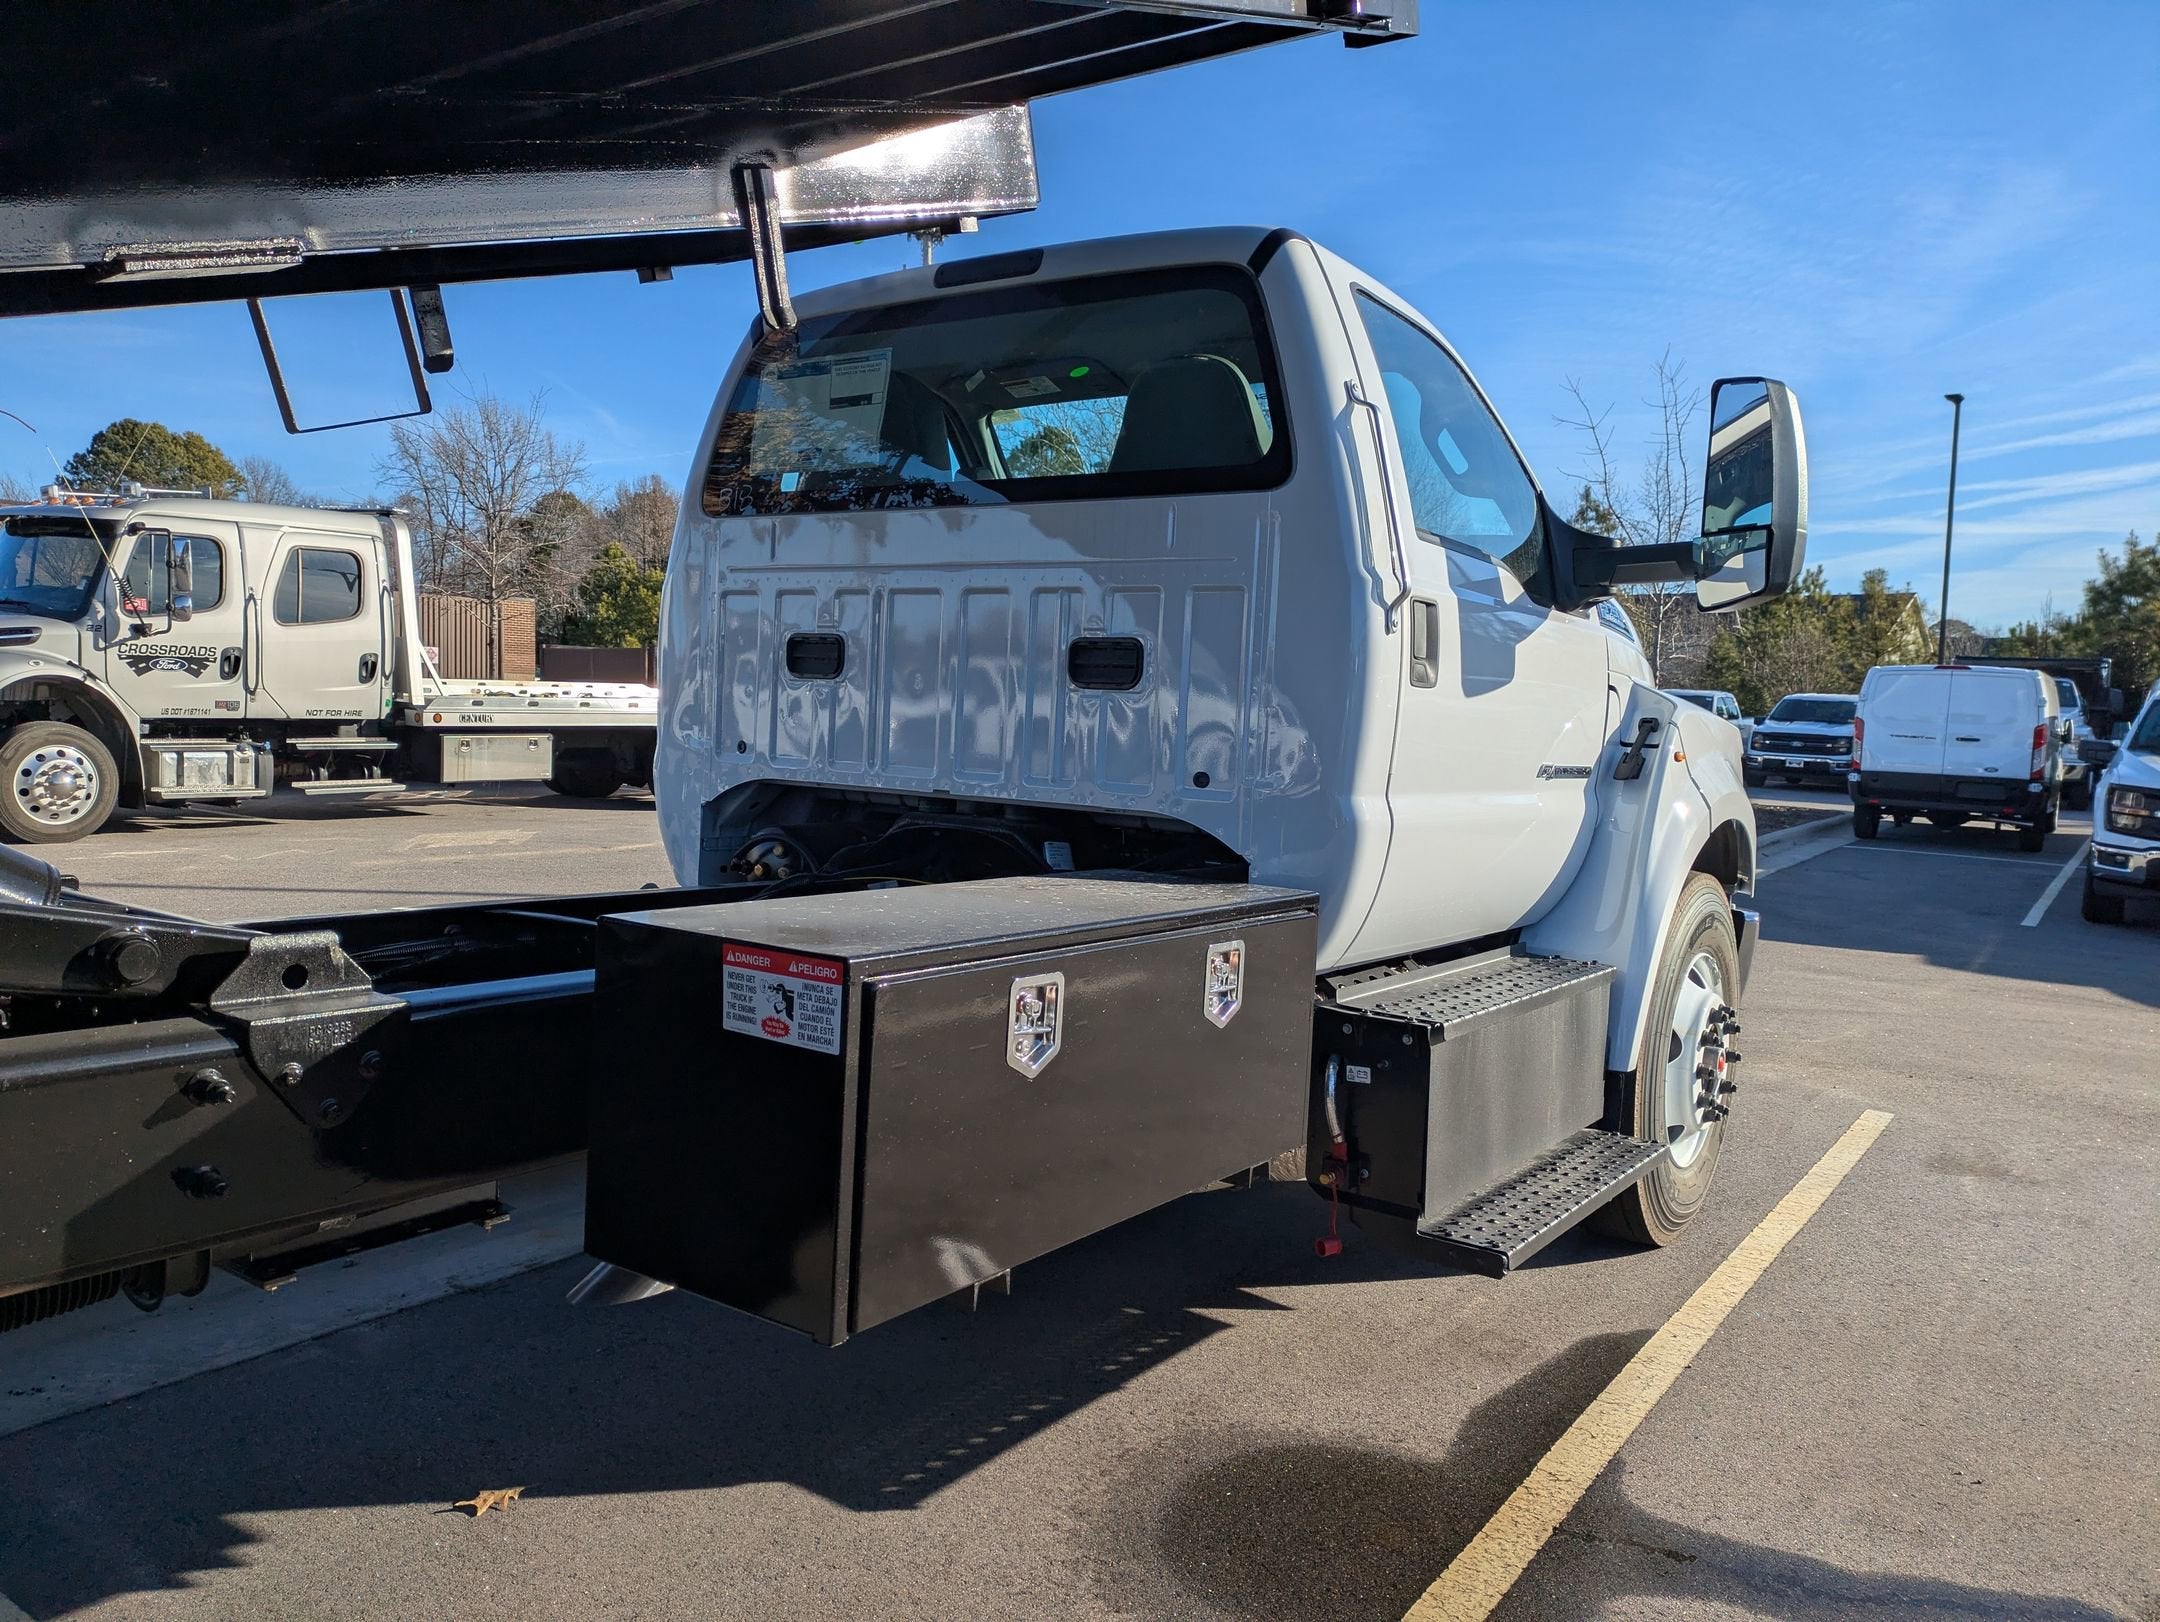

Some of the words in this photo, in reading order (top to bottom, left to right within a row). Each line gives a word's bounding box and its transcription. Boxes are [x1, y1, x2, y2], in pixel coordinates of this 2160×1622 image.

[86, 624, 103, 633] 22
[117, 643, 217, 657] CROSSROADS
[156, 660, 181, 671] Ford
[305, 709, 323, 717] NOT
[344, 709, 363, 717] HIRE
[458, 713, 495, 723] CENTURY
[735, 952, 771, 967] DANGER
[727, 971, 745, 982] NEVER
[746, 974, 756, 984] GET
[798, 963, 838, 979] PELIGRO
[727, 981, 744, 992] UNDER
[744, 985, 757, 995] THIS
[825, 986, 834, 995] SE
[730, 992, 747, 1003] TRUCK
[797, 991, 813, 1003] META
[814, 995, 838, 1007] DEBAJO
[727, 1001, 737, 1011] THE
[738, 1004, 757, 1015] ENGINE
[799, 1002, 810, 1012] DEL
[811, 1003, 835, 1017] CAMIÓN
[732, 1012, 757, 1025] RUNNING!
[800, 1012, 824, 1025] CUANDO
[825, 1017, 833, 1026] EL
[798, 1022, 818, 1033] MOTOR
[820, 1026, 835, 1037] ESTÉ
[798, 1032, 806, 1041] EN
[806, 1033, 834, 1047] MARCHA!
